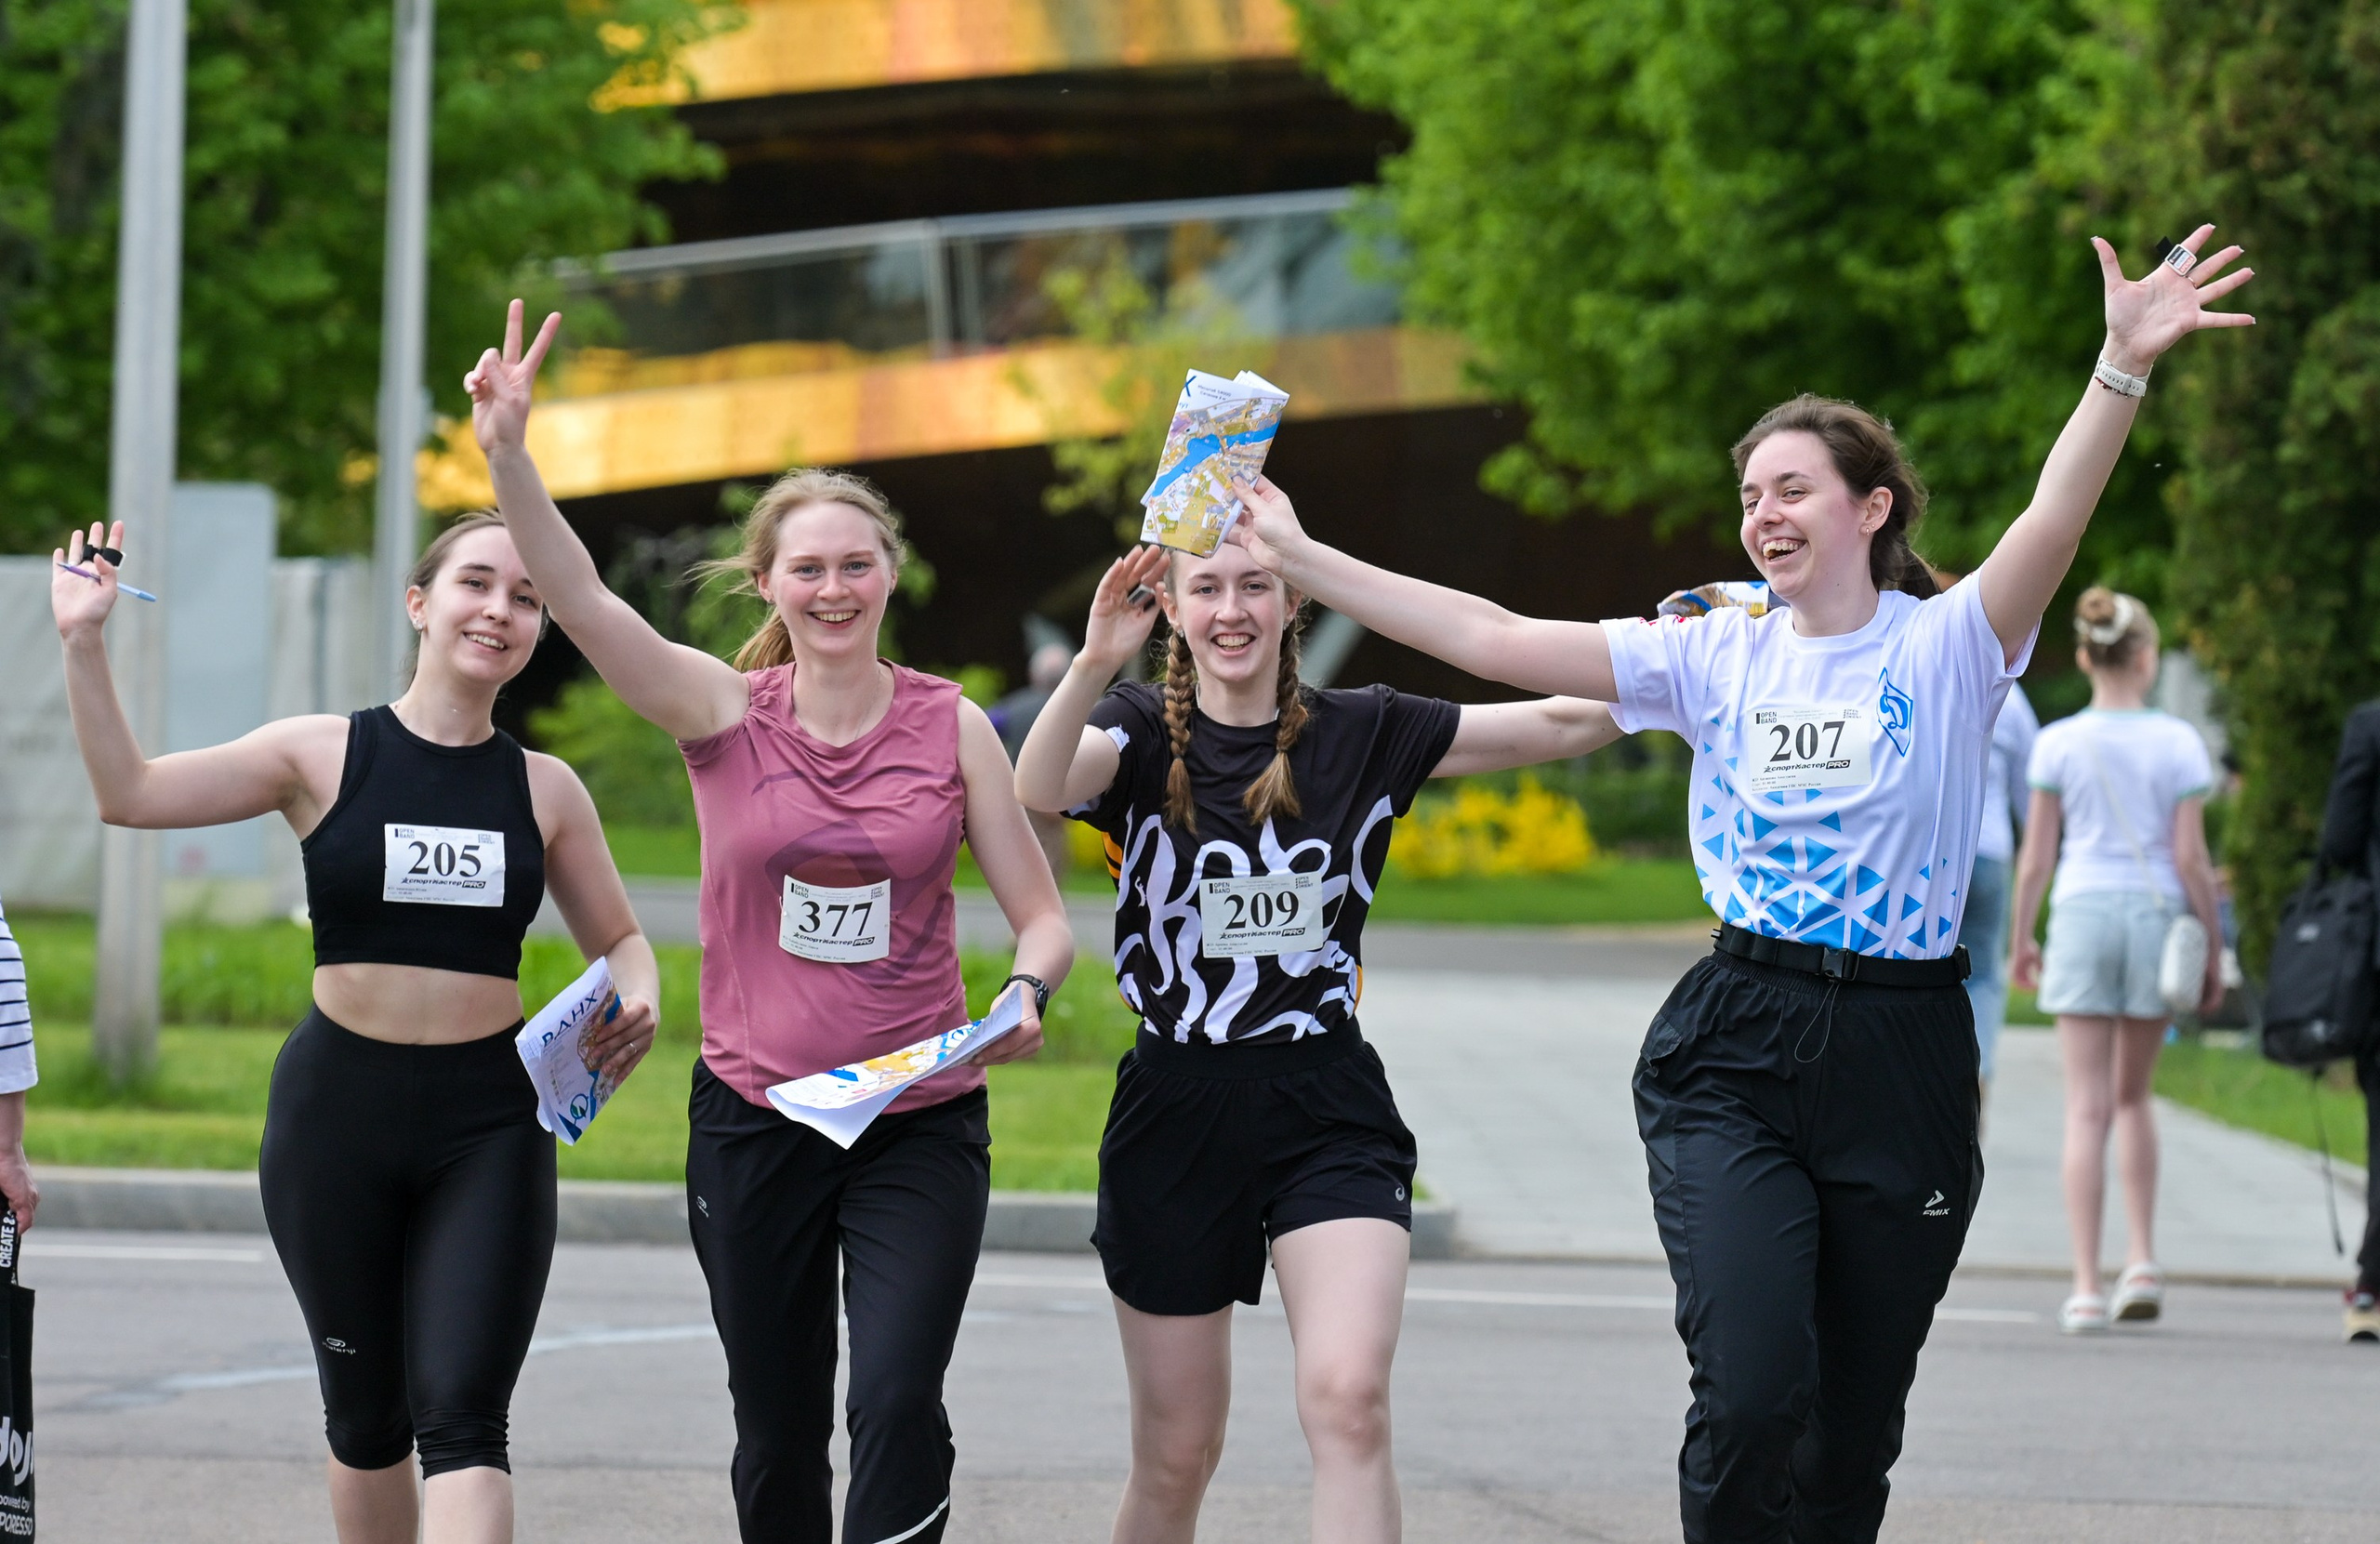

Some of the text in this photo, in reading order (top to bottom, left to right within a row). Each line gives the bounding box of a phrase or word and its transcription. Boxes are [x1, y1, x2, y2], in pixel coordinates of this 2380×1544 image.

[1769, 720, 1845, 762] 207
[1827, 760, 1850, 769] PRO
[407, 840, 482, 878] 205
[463, 880, 485, 889] PRO
[795, 885, 810, 893] OPEN
[795, 890, 809, 899] BAND
[1223, 891, 1299, 930] 209
[798, 901, 873, 938] 377
[1282, 928, 1305, 937] PRO
[853, 937, 875, 946] PRO
[3, 1216, 16, 1225] &
[0, 1225, 15, 1269] CREATE
[21, 1496, 31, 1513] by
